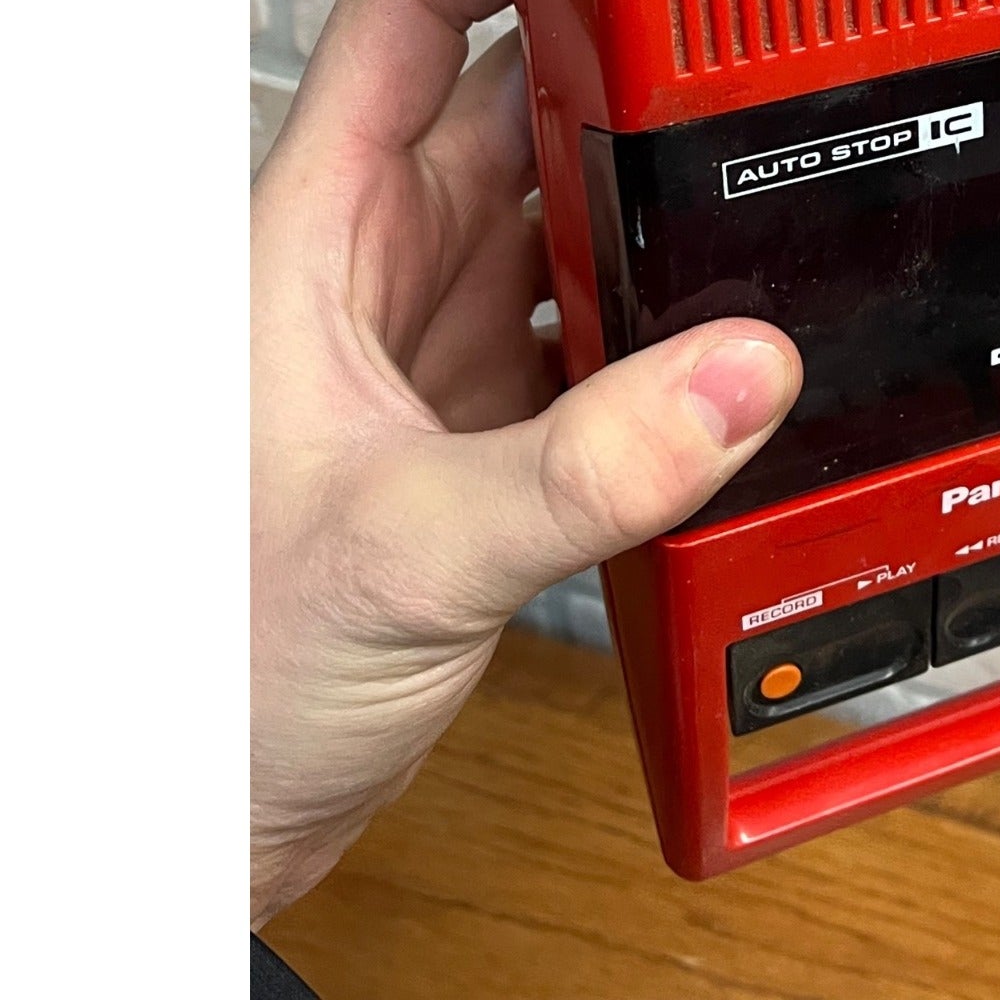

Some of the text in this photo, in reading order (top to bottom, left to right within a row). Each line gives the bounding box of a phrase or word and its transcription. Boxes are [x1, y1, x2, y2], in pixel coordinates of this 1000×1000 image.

[736, 112, 972, 185] AUTO STOP IC
[876, 562, 916, 584] PLAY
[748, 595, 817, 626] RECORD
